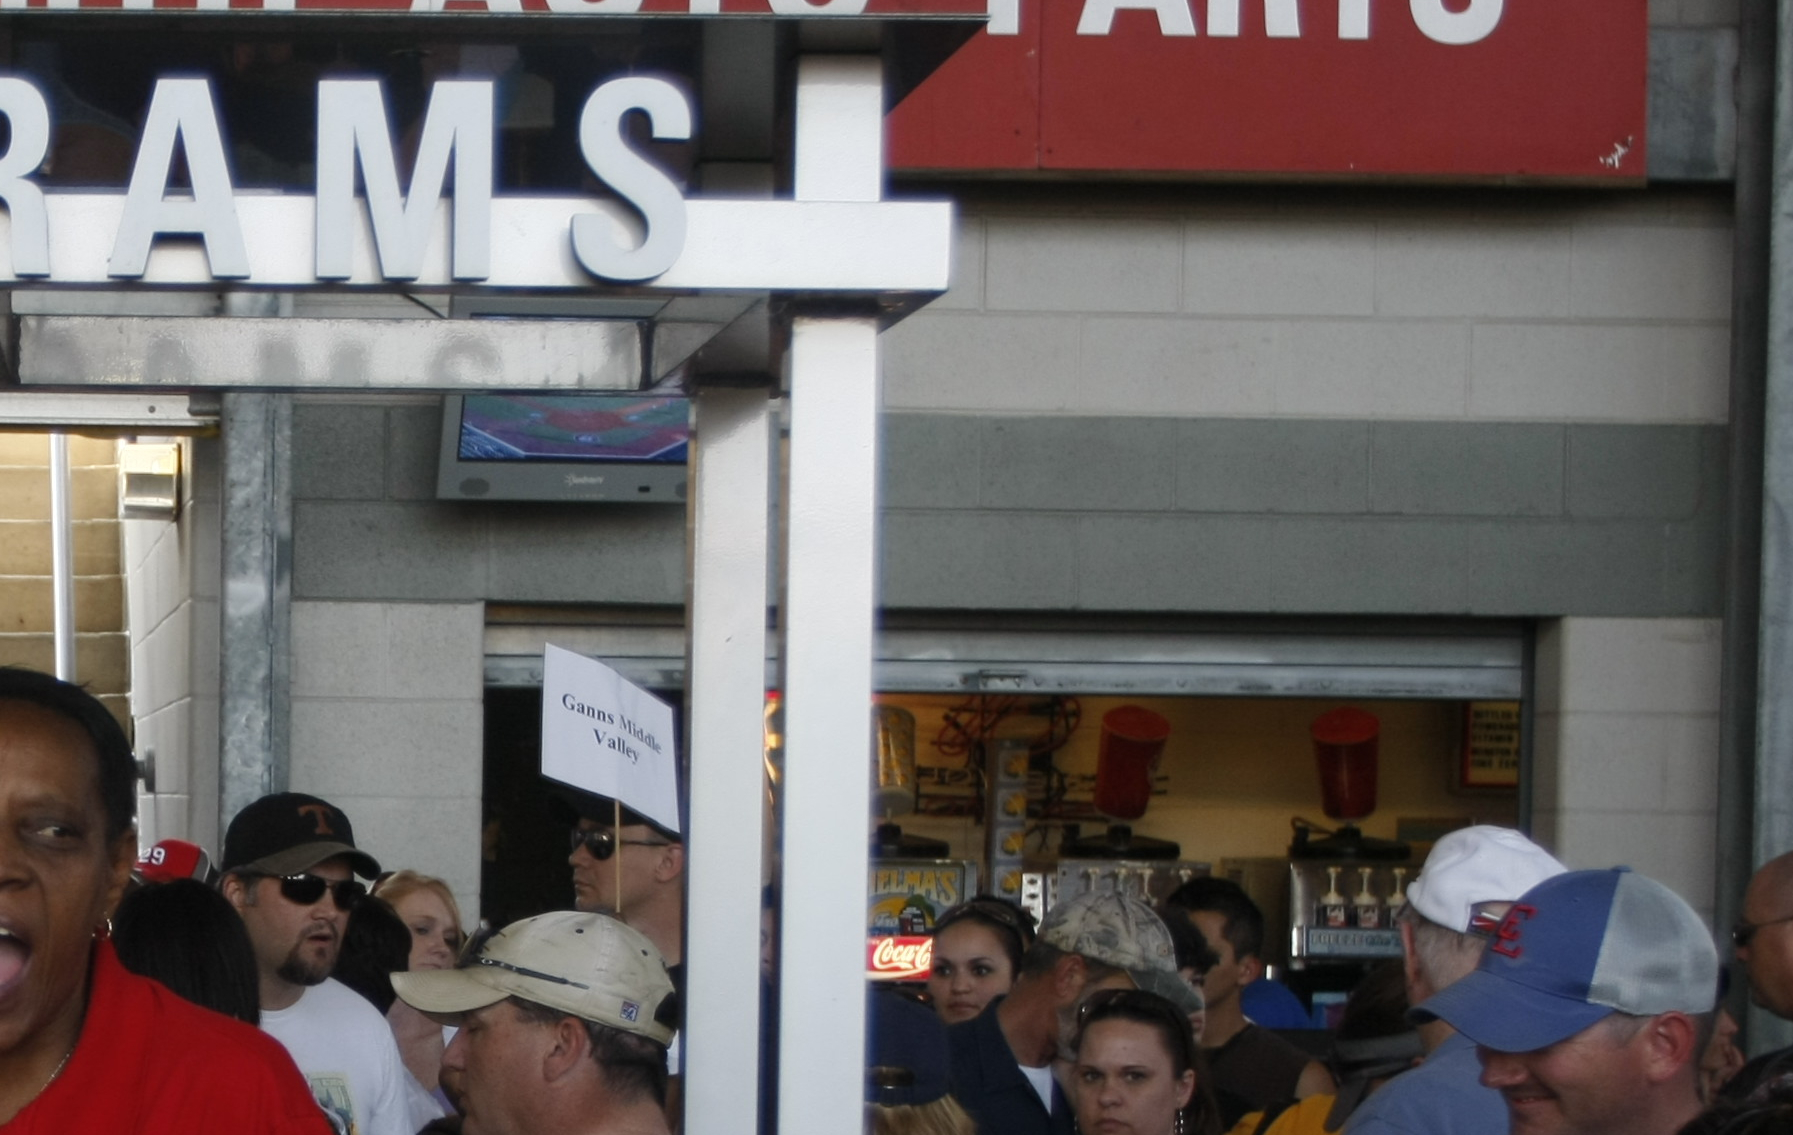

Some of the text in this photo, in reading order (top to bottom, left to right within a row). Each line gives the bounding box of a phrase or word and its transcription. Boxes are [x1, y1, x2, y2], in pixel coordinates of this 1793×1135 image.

[562, 693, 662, 754] Ganns Middle
[593, 728, 640, 764] Valley
[298, 804, 334, 835] T
[139, 847, 165, 865] 29
